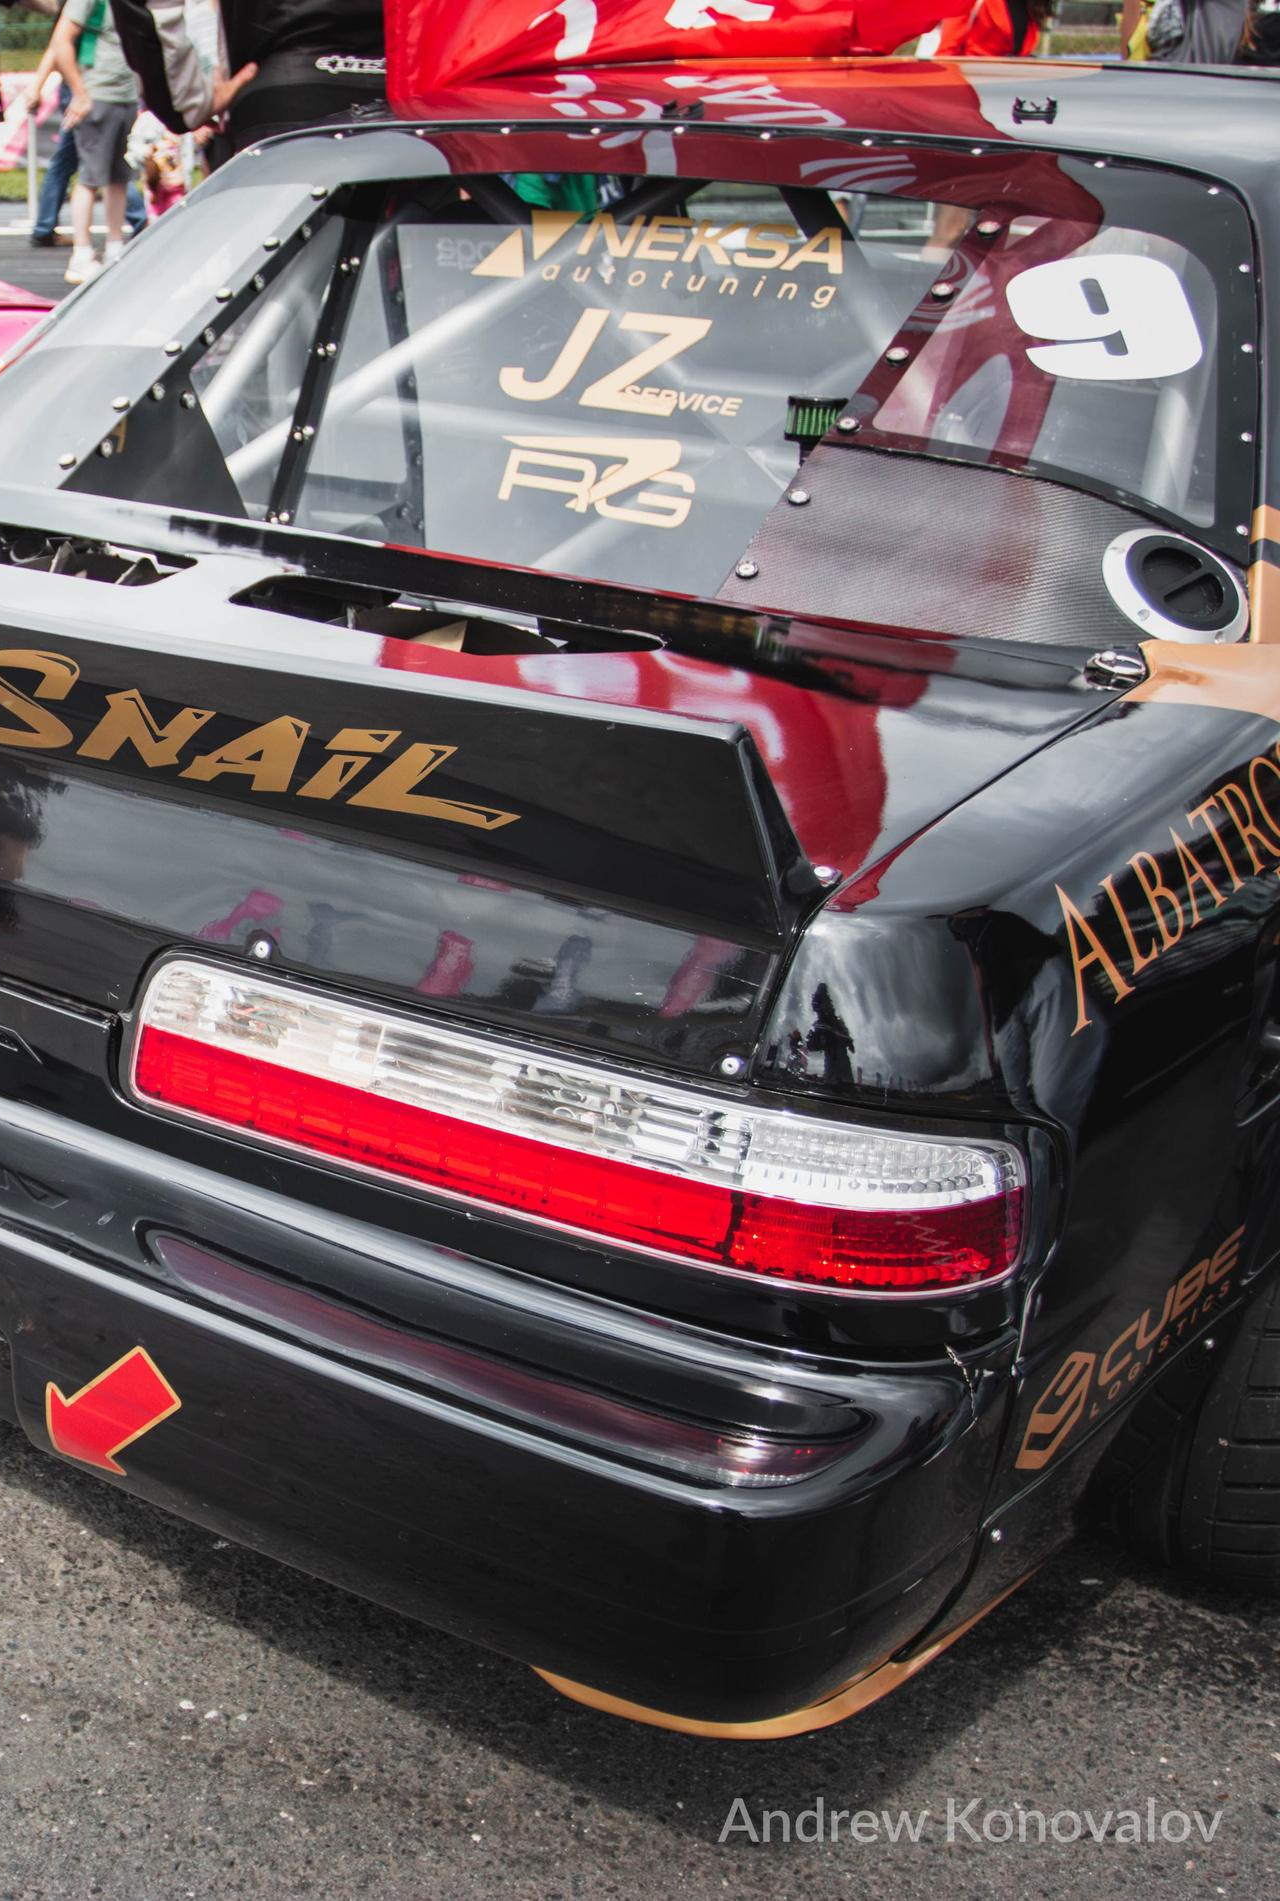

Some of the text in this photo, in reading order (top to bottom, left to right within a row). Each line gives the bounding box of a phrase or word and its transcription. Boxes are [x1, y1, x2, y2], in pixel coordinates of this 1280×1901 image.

[541, 263, 837, 309] autotuning
[577, 212, 844, 275] NEKSA
[498, 307, 713, 416] JZ
[1005, 253, 1204, 381] 9
[624, 384, 744, 417] SERVICE
[1054, 738, 1280, 1037] ALBATRO
[1088, 1280, 1231, 1420] LOGISTICS
[1097, 1223, 1246, 1387] CUBE
